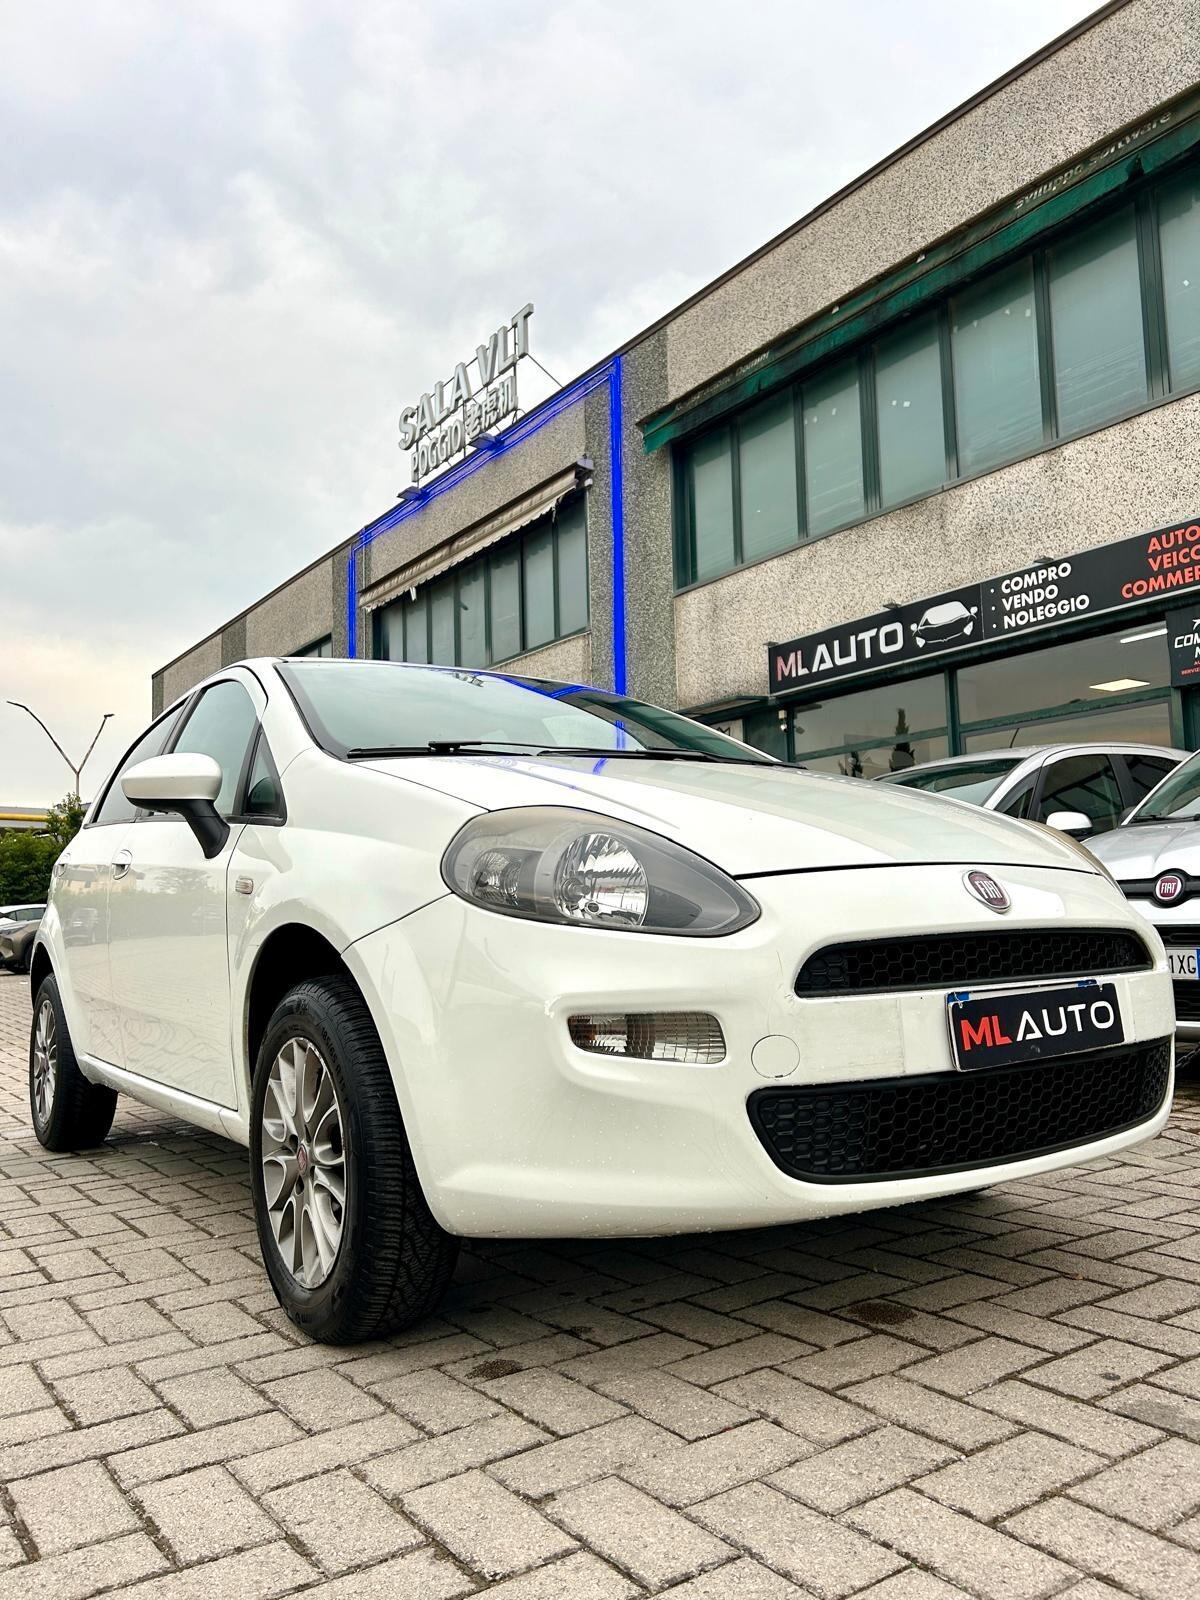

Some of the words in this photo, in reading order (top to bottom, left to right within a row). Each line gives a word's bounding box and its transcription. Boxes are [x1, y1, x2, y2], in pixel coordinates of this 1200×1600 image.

[398, 362, 472, 451] SALA
[476, 303, 534, 388] VLT
[411, 418, 465, 482] POGGIO
[1001, 562, 1072, 595] COMPRO
[1002, 584, 1059, 611] VENDO
[1003, 594, 1090, 630] NOLEGGIO
[974, 880, 1003, 899] FIAT
[1161, 882, 1177, 894] FIAT
